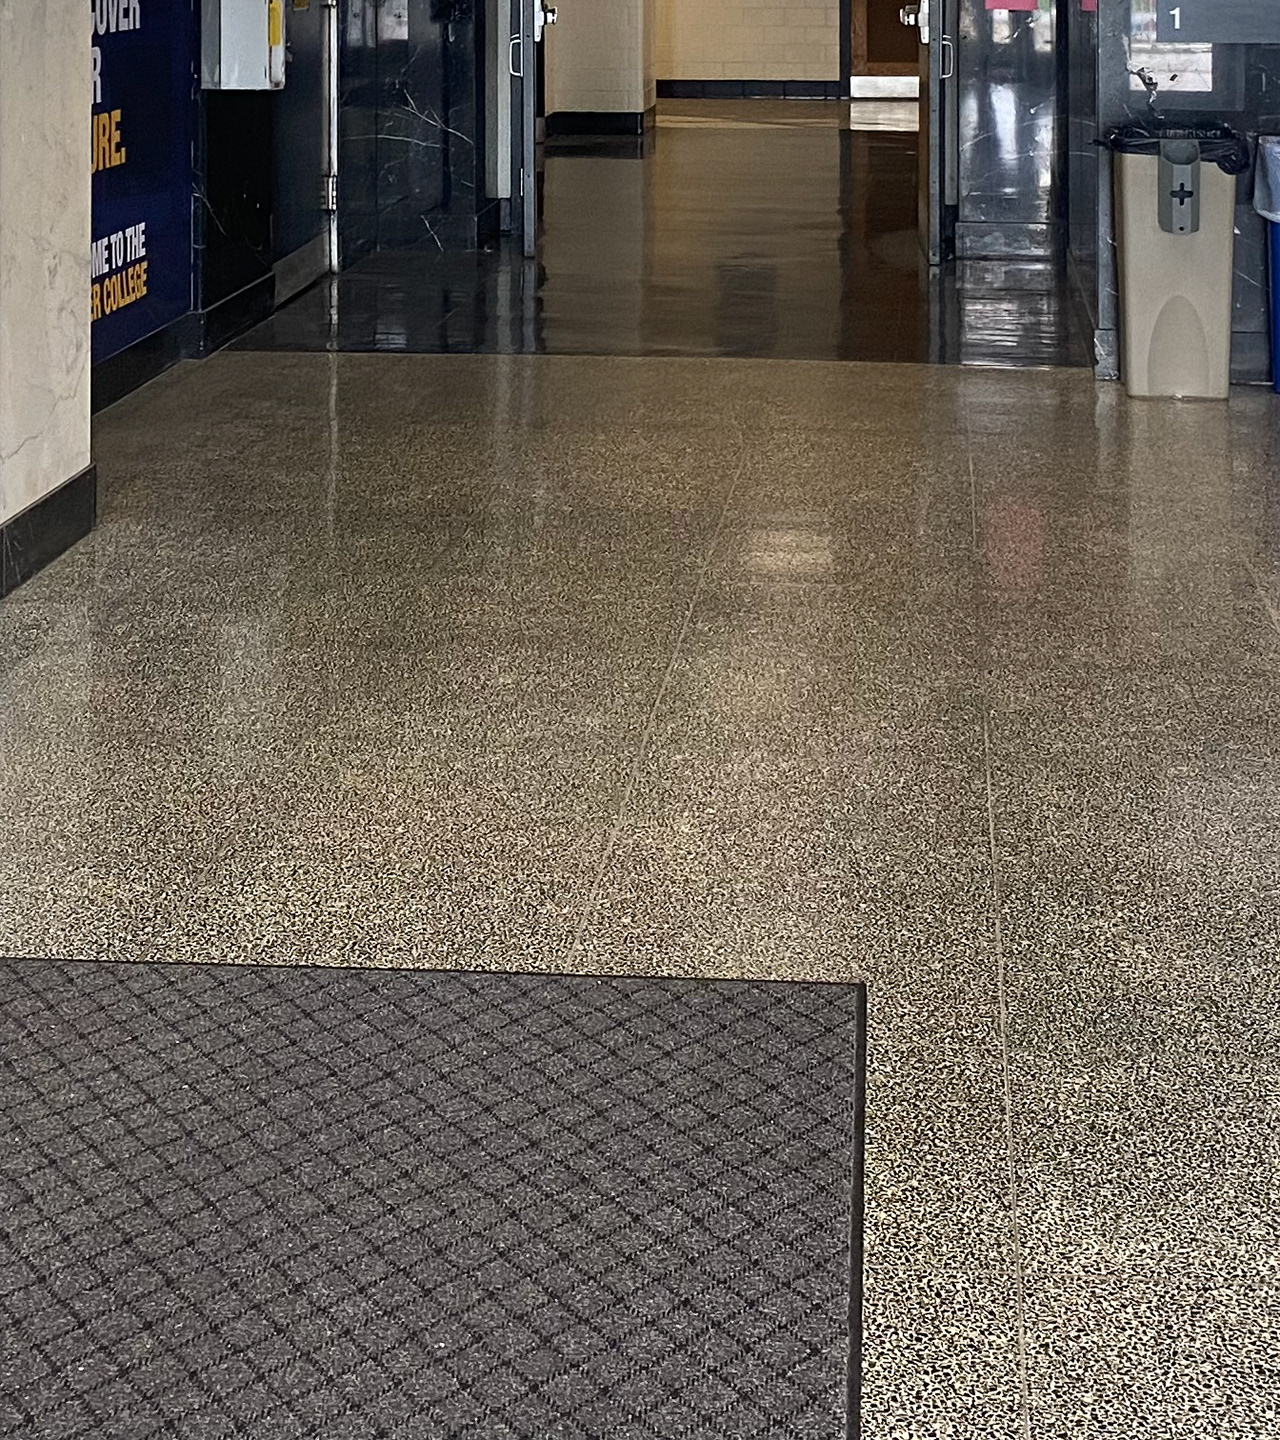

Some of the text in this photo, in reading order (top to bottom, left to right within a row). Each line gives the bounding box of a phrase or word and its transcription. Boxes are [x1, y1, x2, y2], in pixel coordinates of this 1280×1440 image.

[1169, 7, 1181, 30] 1
[110, 231, 124, 269] TO
[125, 222, 146, 262] THE
[103, 260, 148, 315] COLLEGE
